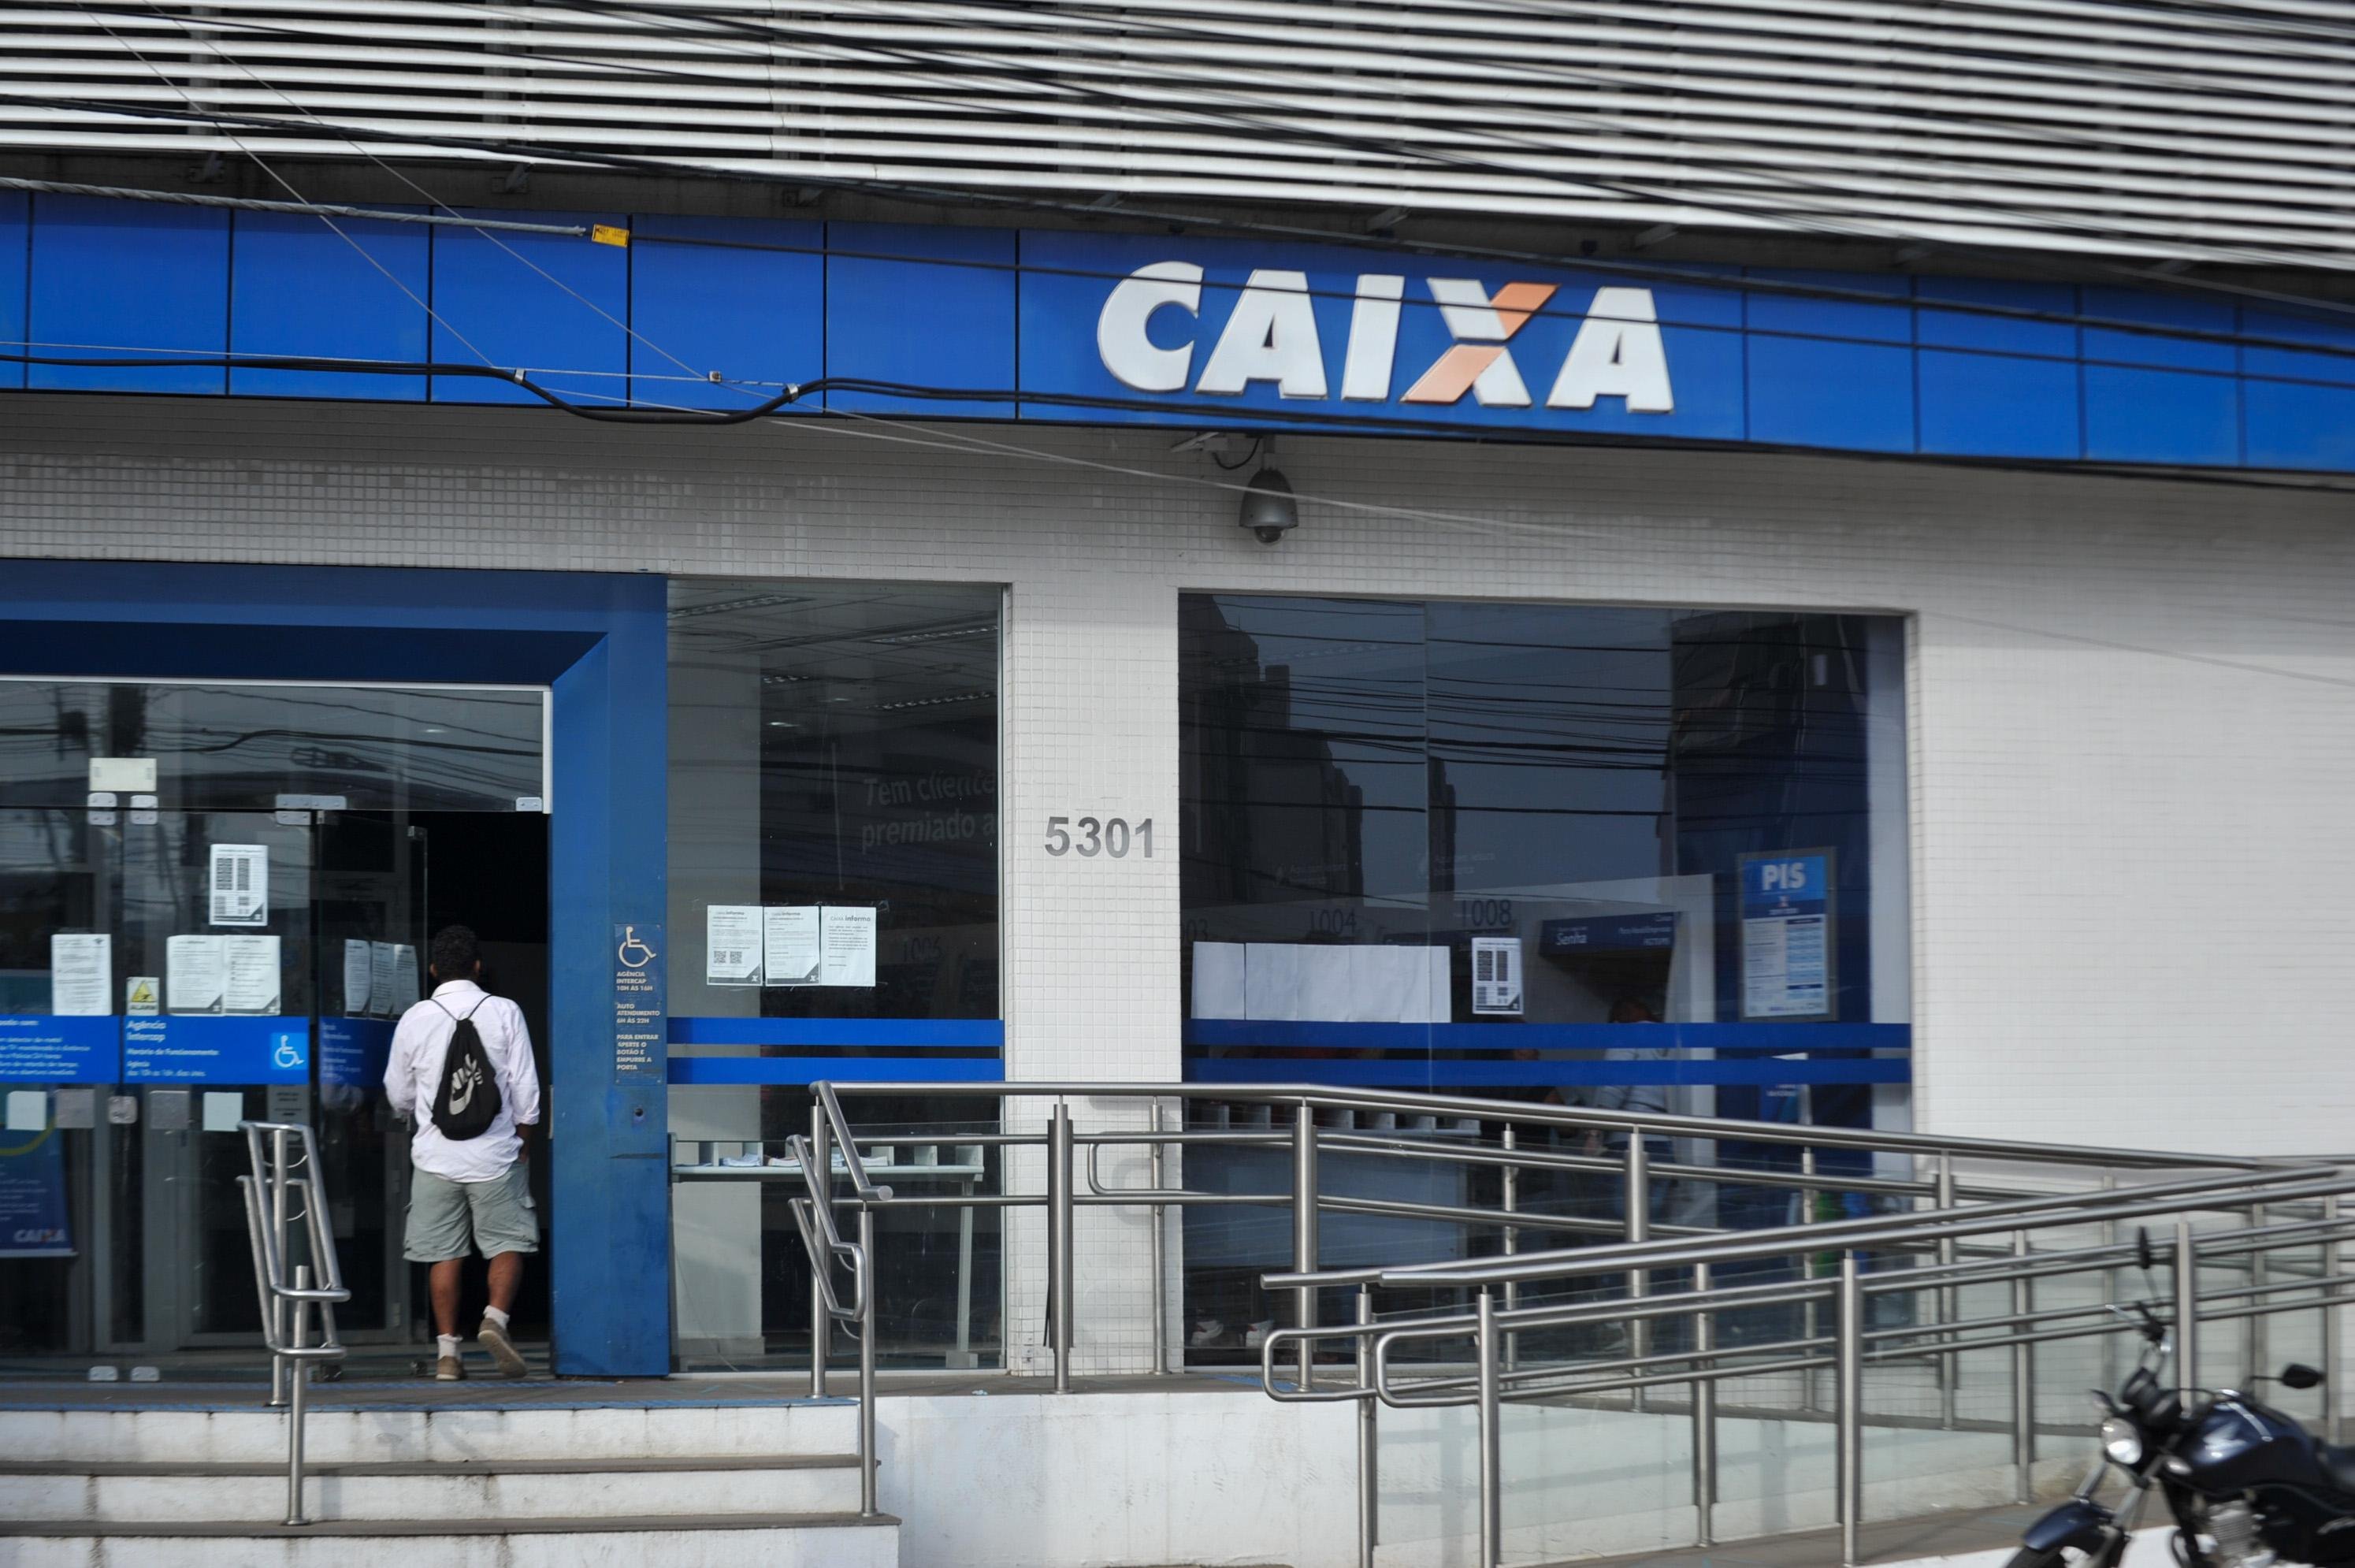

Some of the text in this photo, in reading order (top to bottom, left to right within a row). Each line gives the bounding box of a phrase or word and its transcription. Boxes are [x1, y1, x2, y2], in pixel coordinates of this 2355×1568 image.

[1096, 261, 1674, 414] CAIXA
[864, 778, 912, 805] Tem
[862, 808, 975, 855] premiado
[1045, 816, 1152, 858] 5301
[1762, 862, 1807, 890] PIS
[1309, 908, 1358, 936] 1004
[1461, 899, 1513, 927] 1008
[126, 1020, 166, 1031] Agência
[13, 1228, 67, 1243] CAIXA
